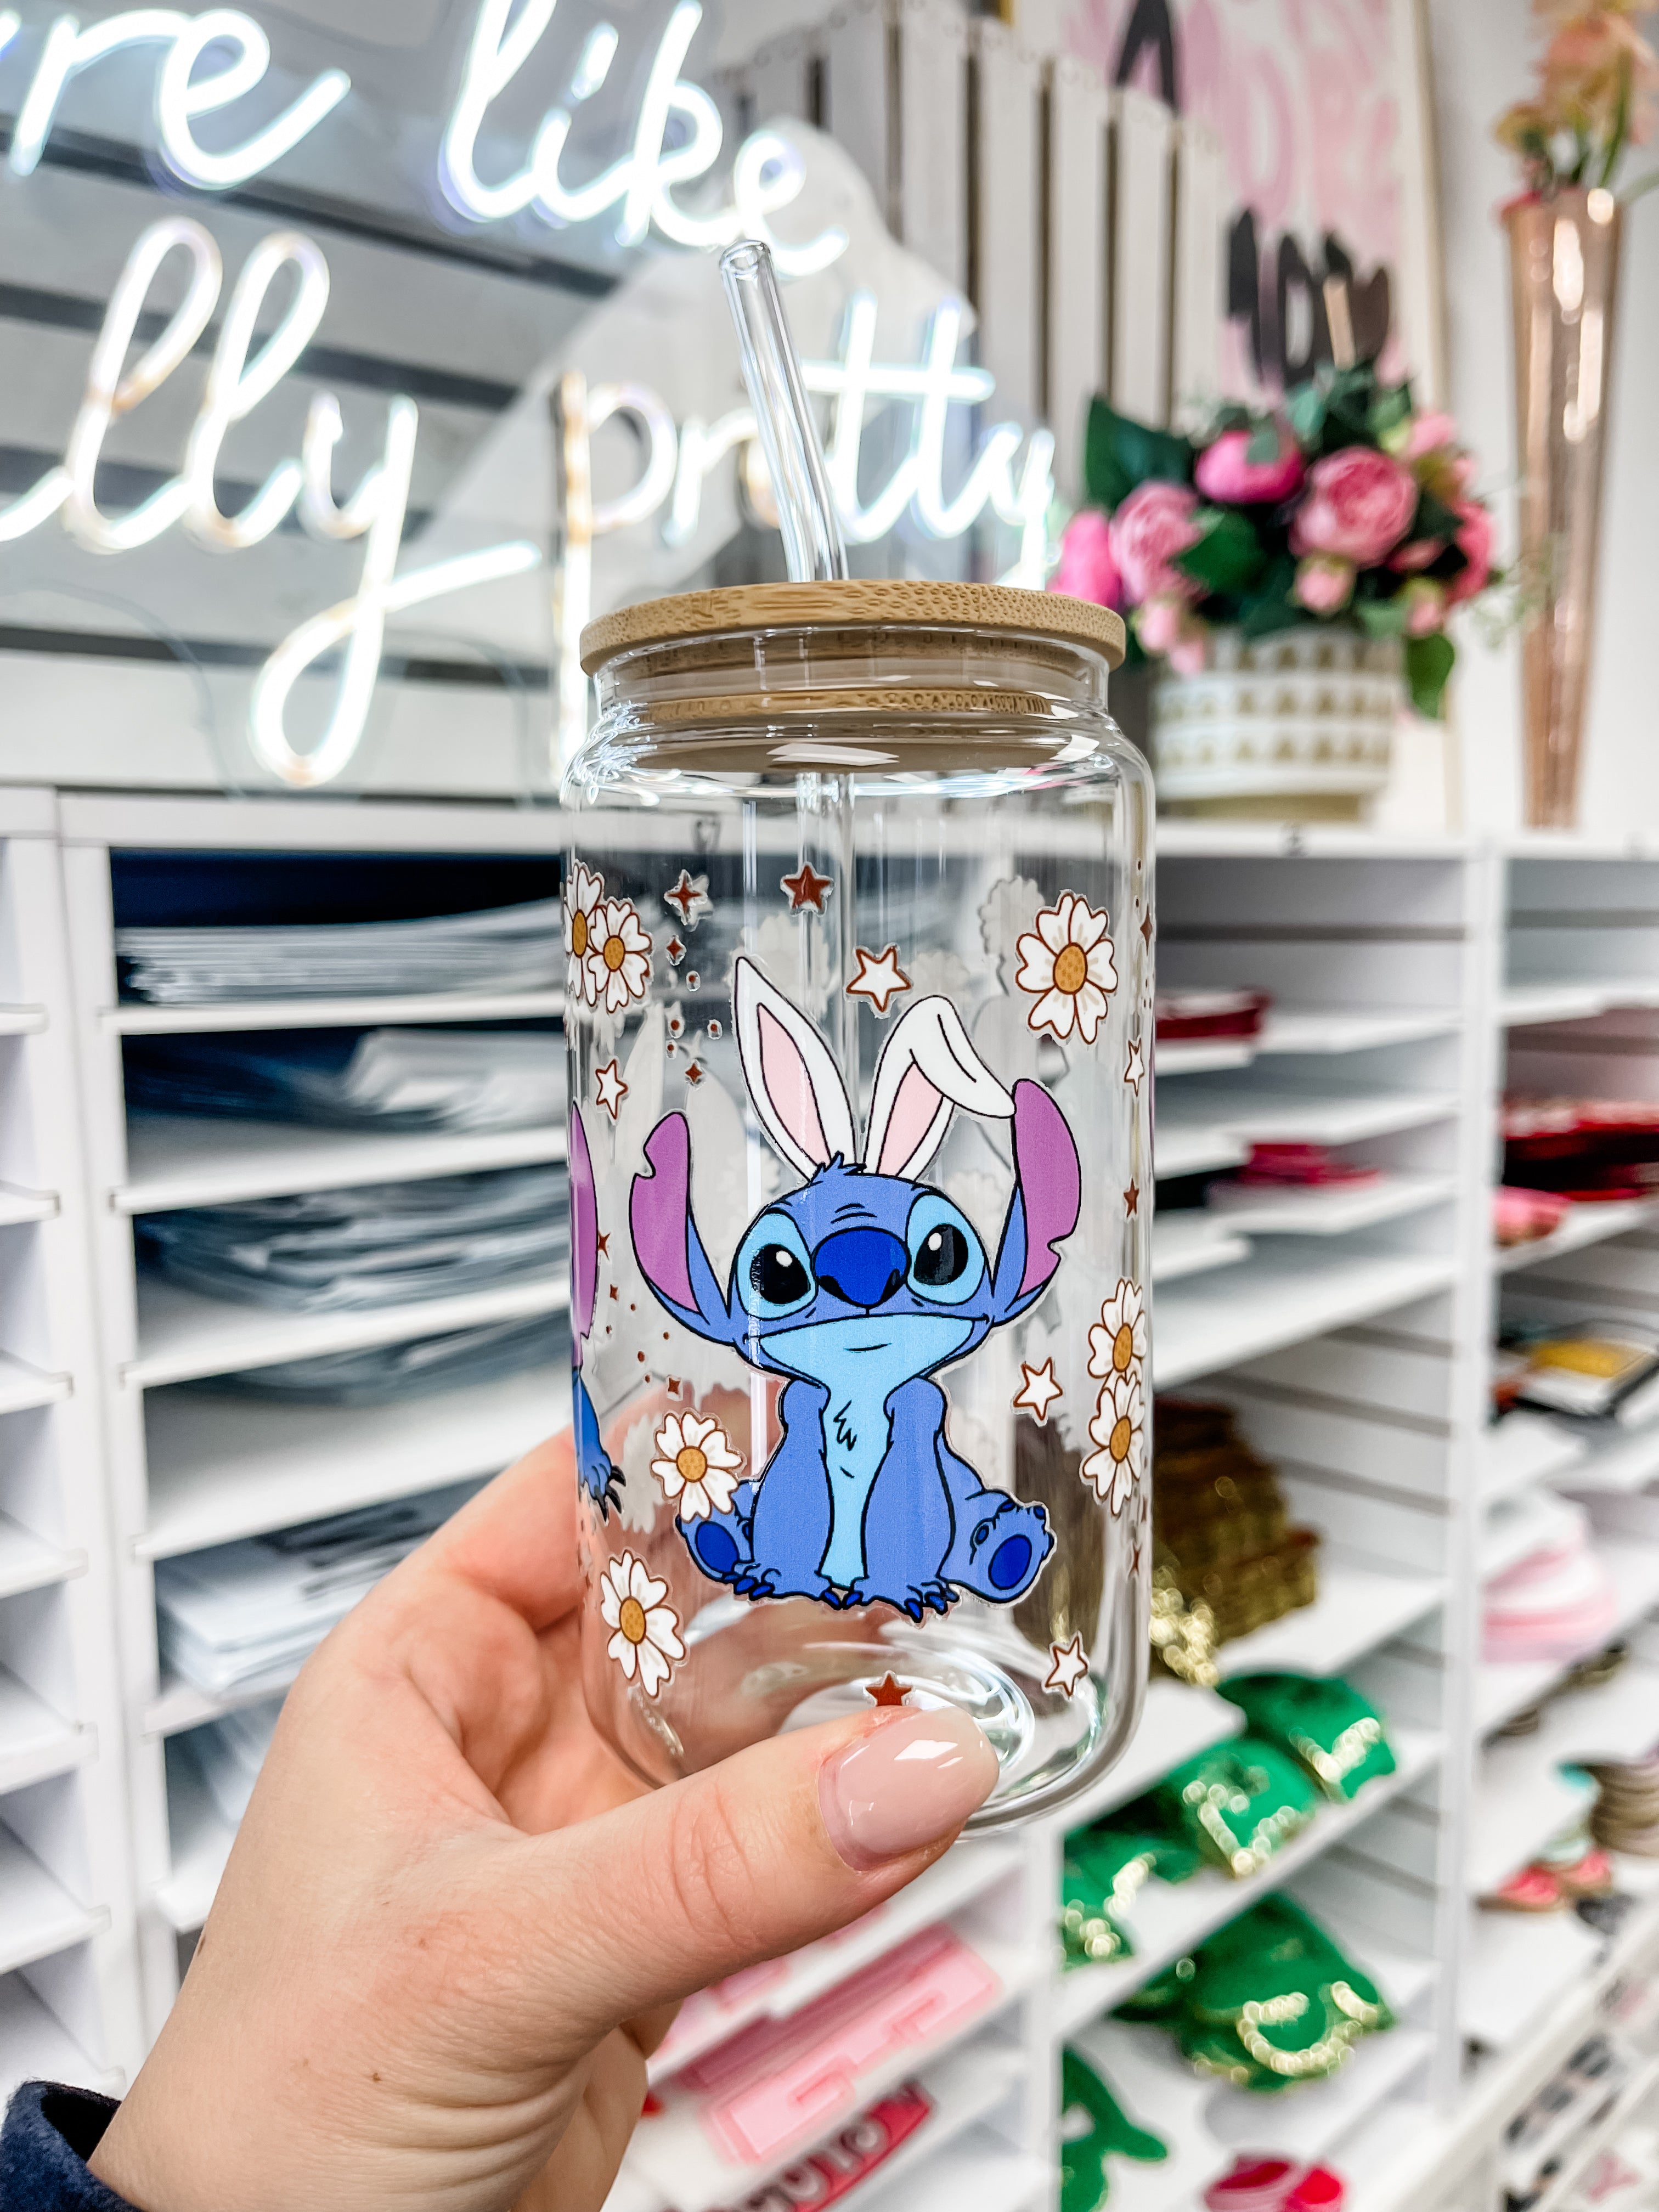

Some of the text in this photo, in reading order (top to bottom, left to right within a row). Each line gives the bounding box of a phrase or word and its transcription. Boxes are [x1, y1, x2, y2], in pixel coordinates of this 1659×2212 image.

[0, 0, 850, 279] re like
[0, 217, 540, 787] lly
